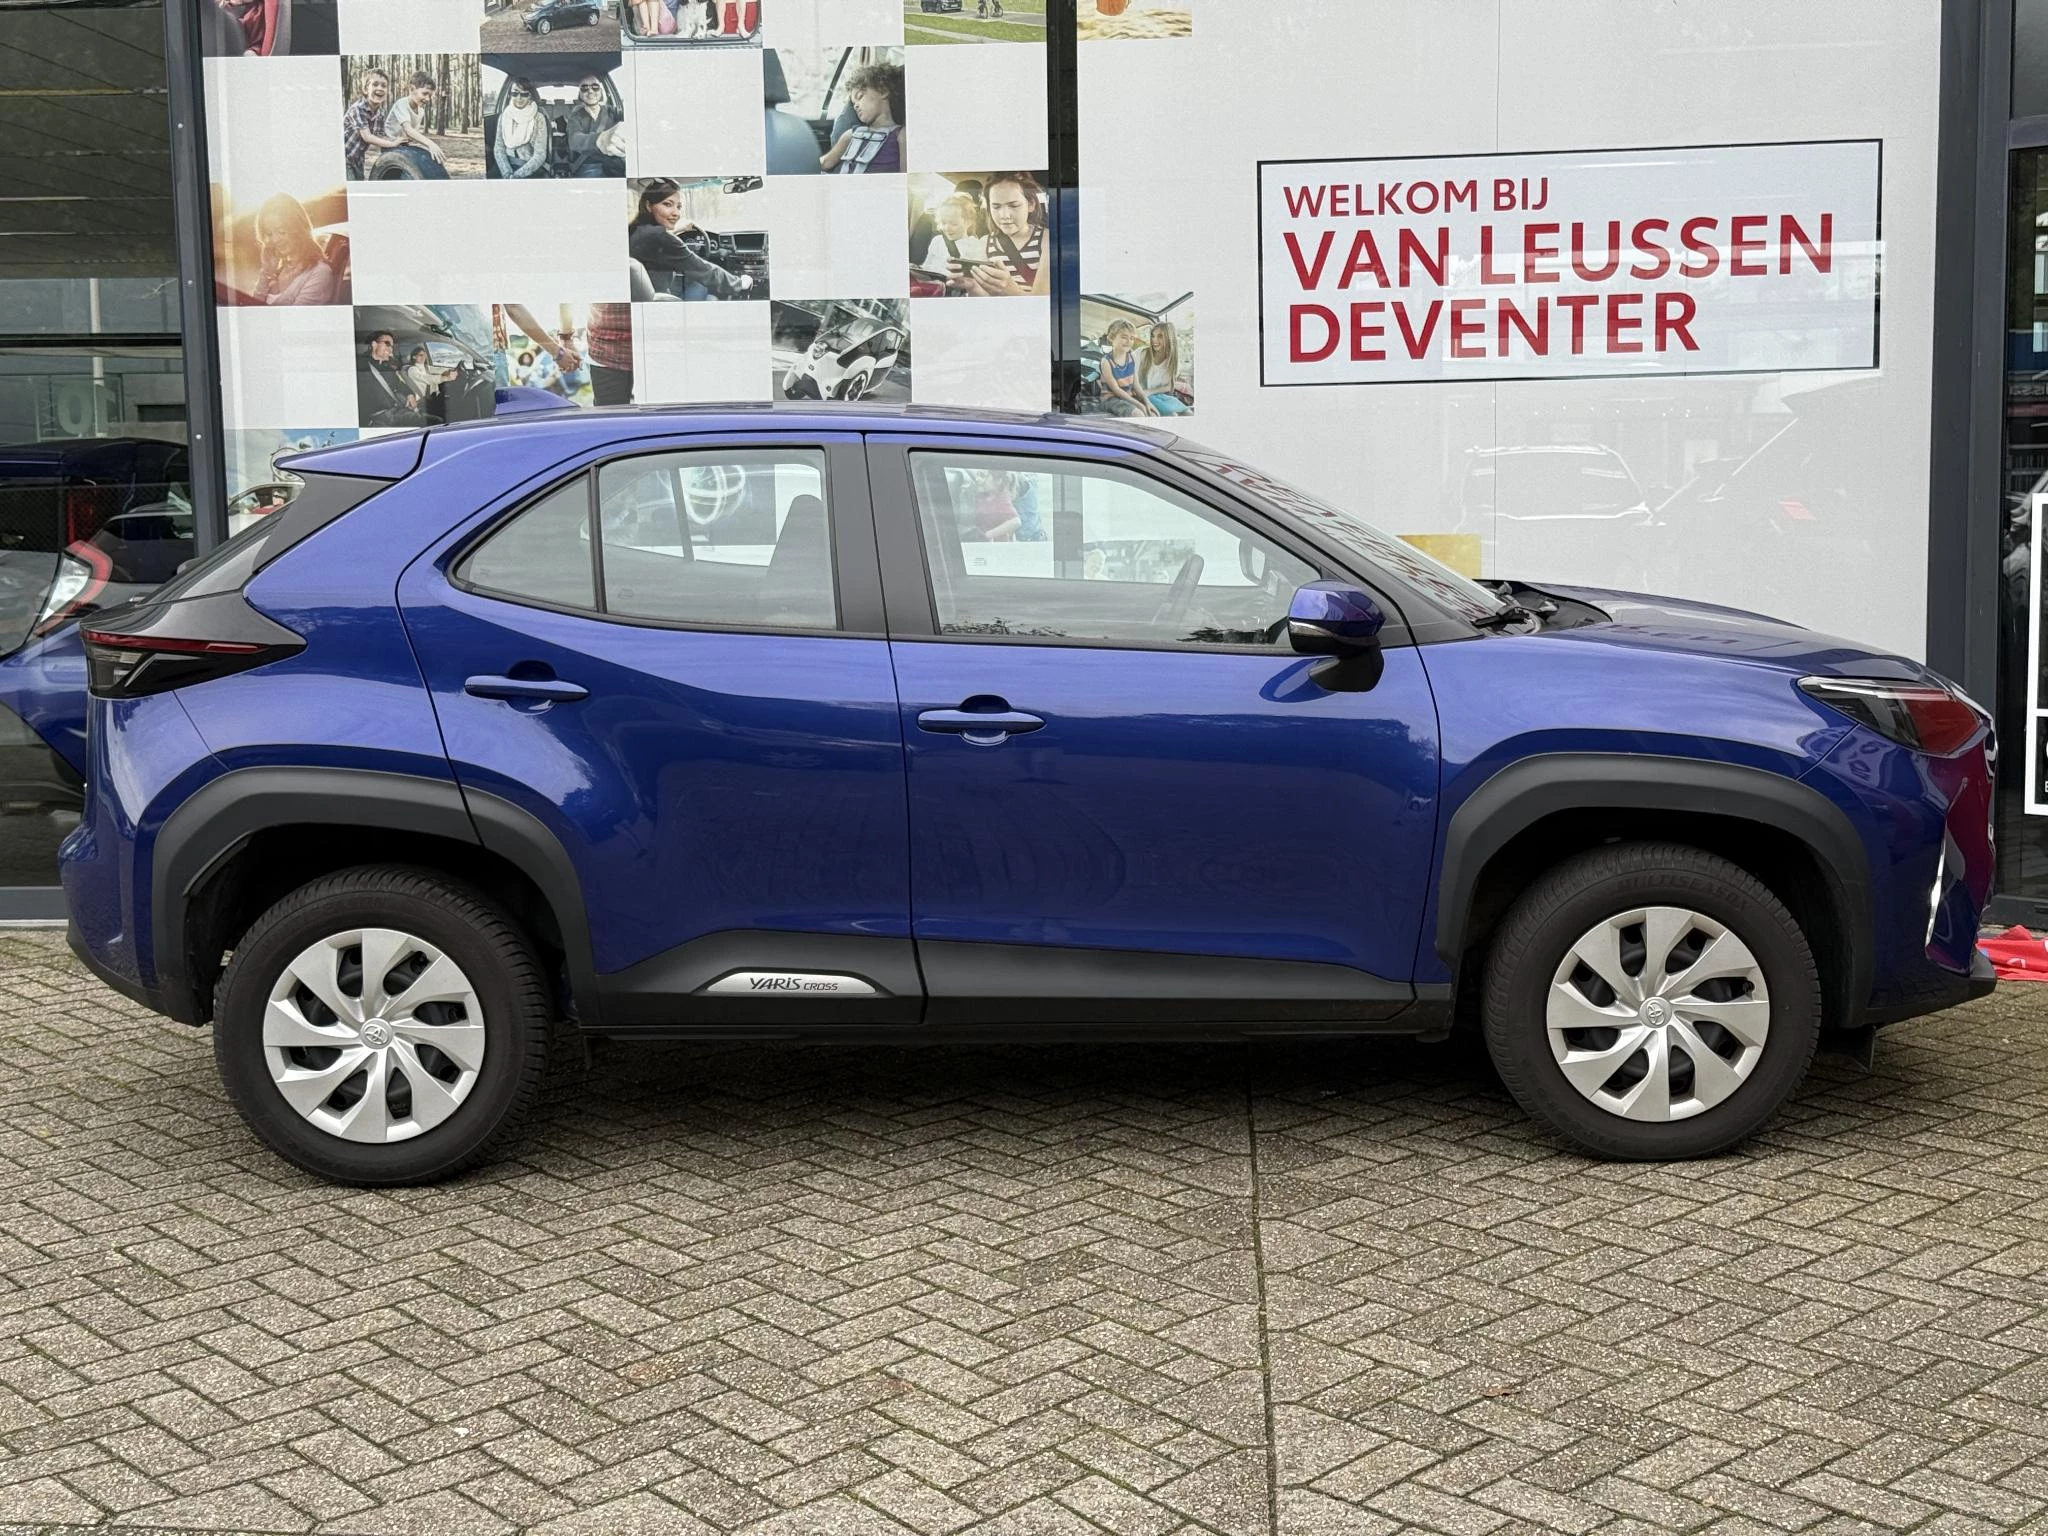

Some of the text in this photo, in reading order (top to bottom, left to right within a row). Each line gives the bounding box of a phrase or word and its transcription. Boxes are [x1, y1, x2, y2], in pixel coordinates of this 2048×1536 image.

[1284, 177, 1549, 218] WELKOM BIJ
[1284, 212, 1833, 290] VAN LEUSSEN
[1289, 292, 1699, 363] DEVENTER
[803, 982, 839, 991] CROSS
